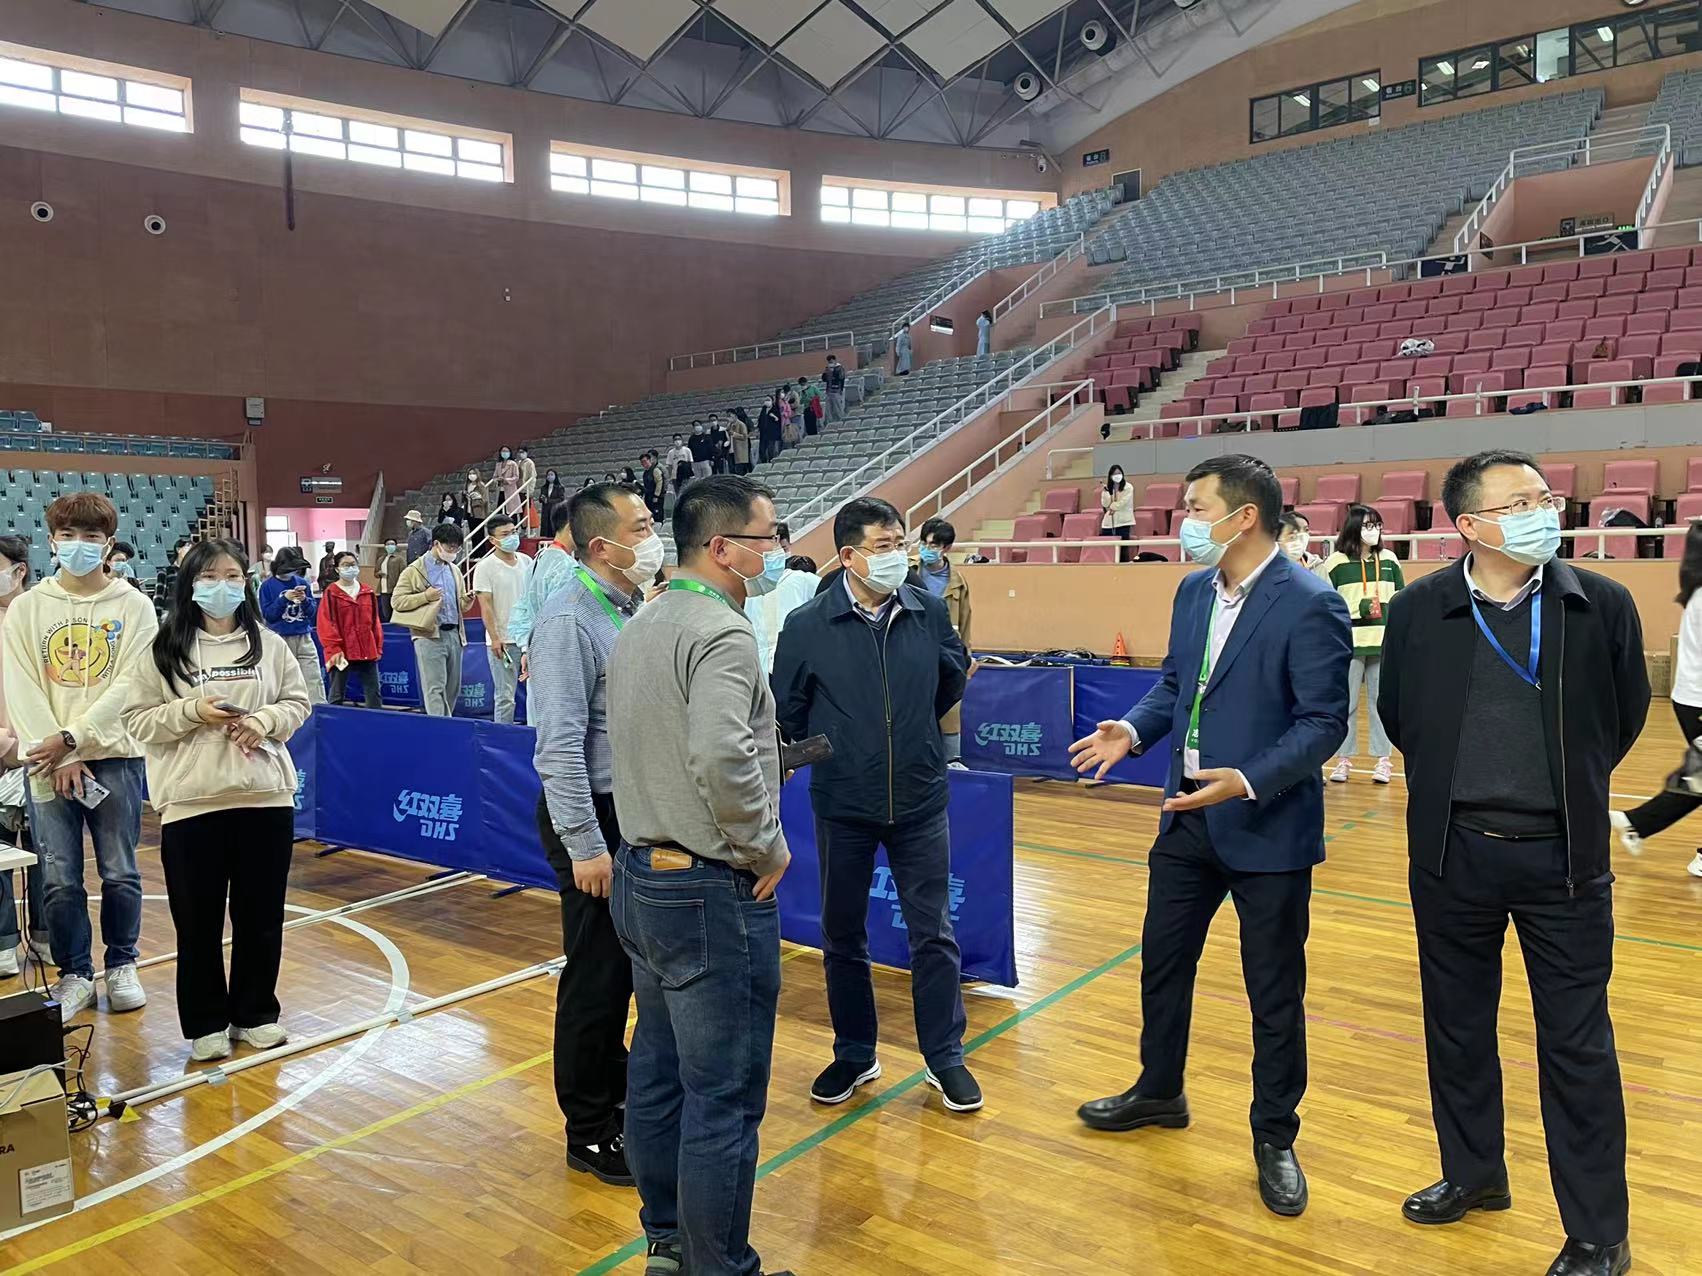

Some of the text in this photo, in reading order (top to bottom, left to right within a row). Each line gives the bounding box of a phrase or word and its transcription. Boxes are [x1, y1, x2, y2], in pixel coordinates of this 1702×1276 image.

[46, 621, 64, 635] WITH
[390, 684, 409, 694] DHS
[464, 697, 485, 708] DHS
[974, 721, 1043, 746] 红双喜
[1003, 742, 1041, 756] DHS
[393, 789, 463, 822] 红双喜
[419, 819, 460, 841] DHS
